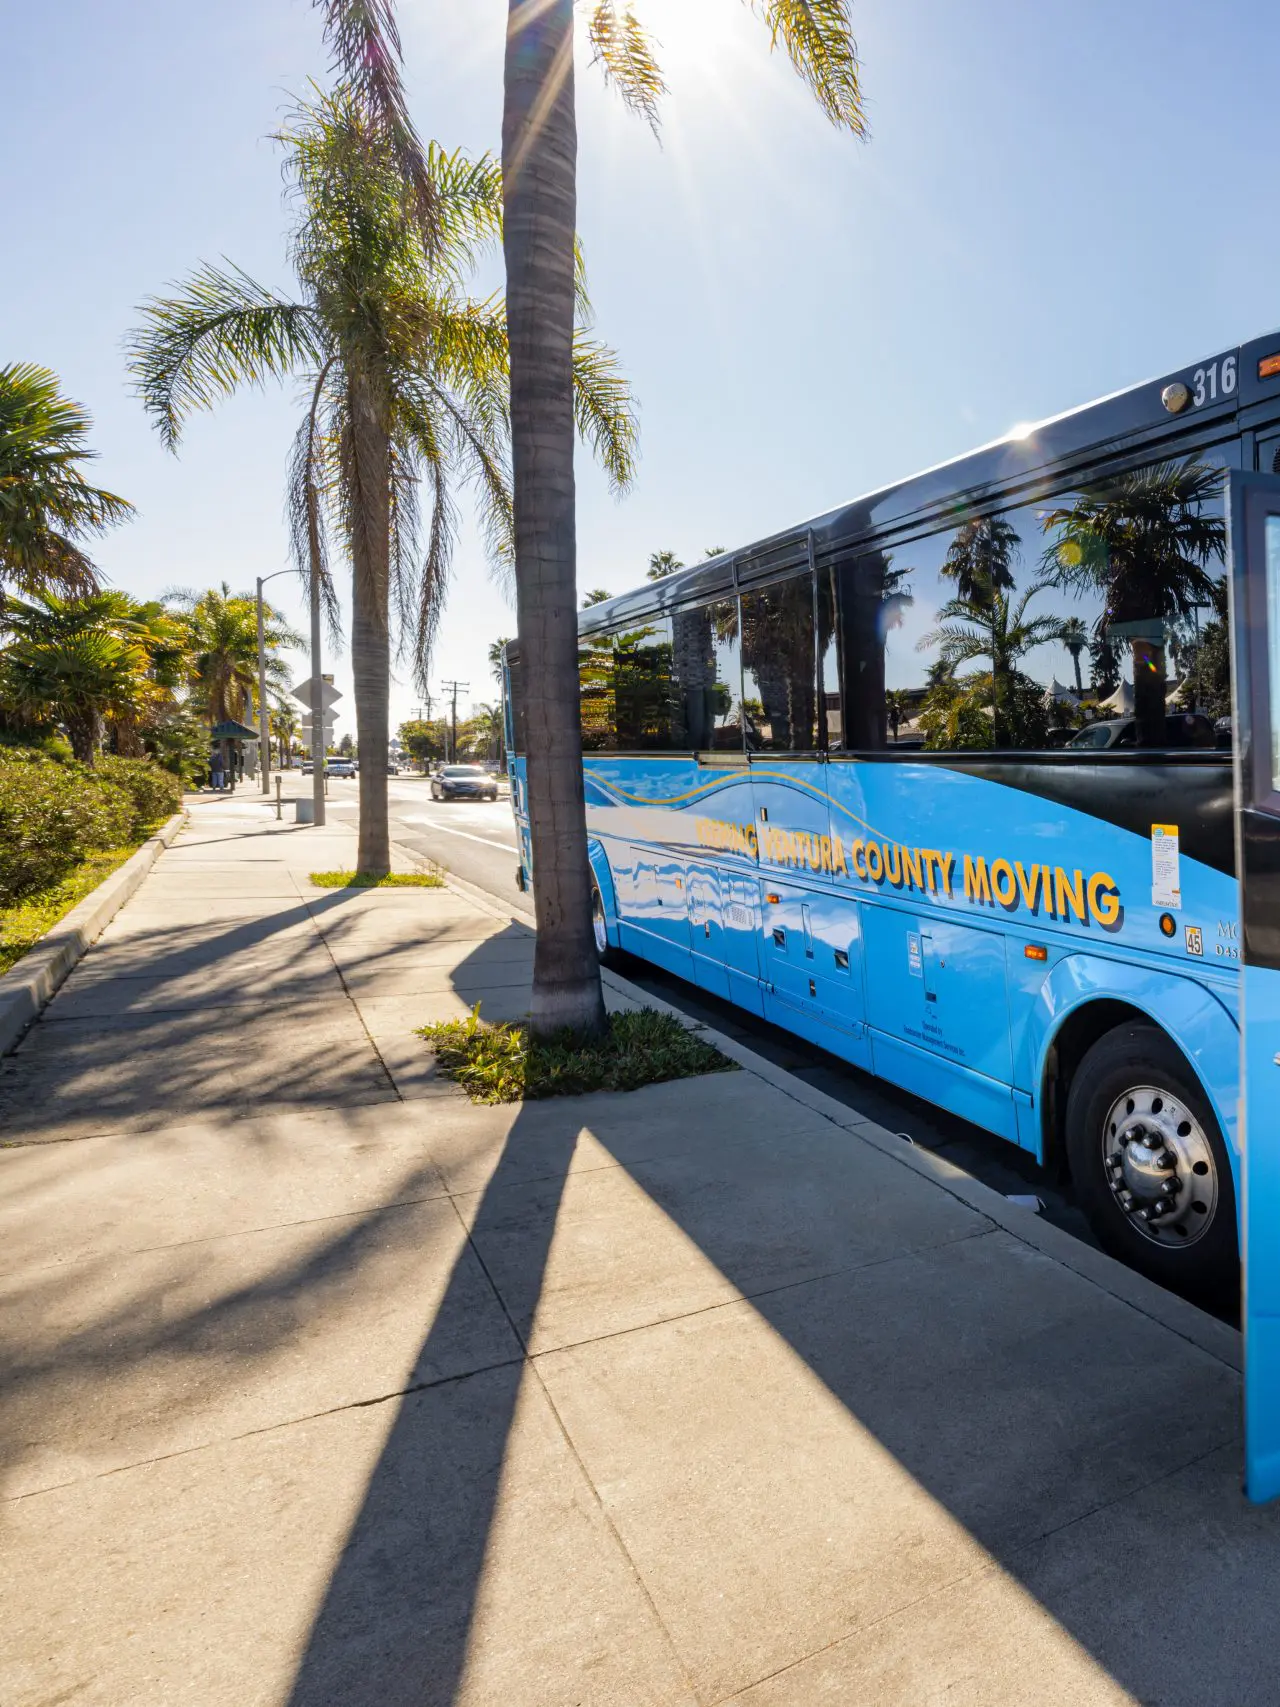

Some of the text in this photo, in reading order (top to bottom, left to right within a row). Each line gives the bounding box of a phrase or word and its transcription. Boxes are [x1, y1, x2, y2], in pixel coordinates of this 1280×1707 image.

[1193, 356, 1236, 407] 316
[695, 818, 1123, 931] KEEPING VENTURA COUNTY MOVING
[1186, 932, 1202, 954] 45
[1216, 919, 1240, 940] MC
